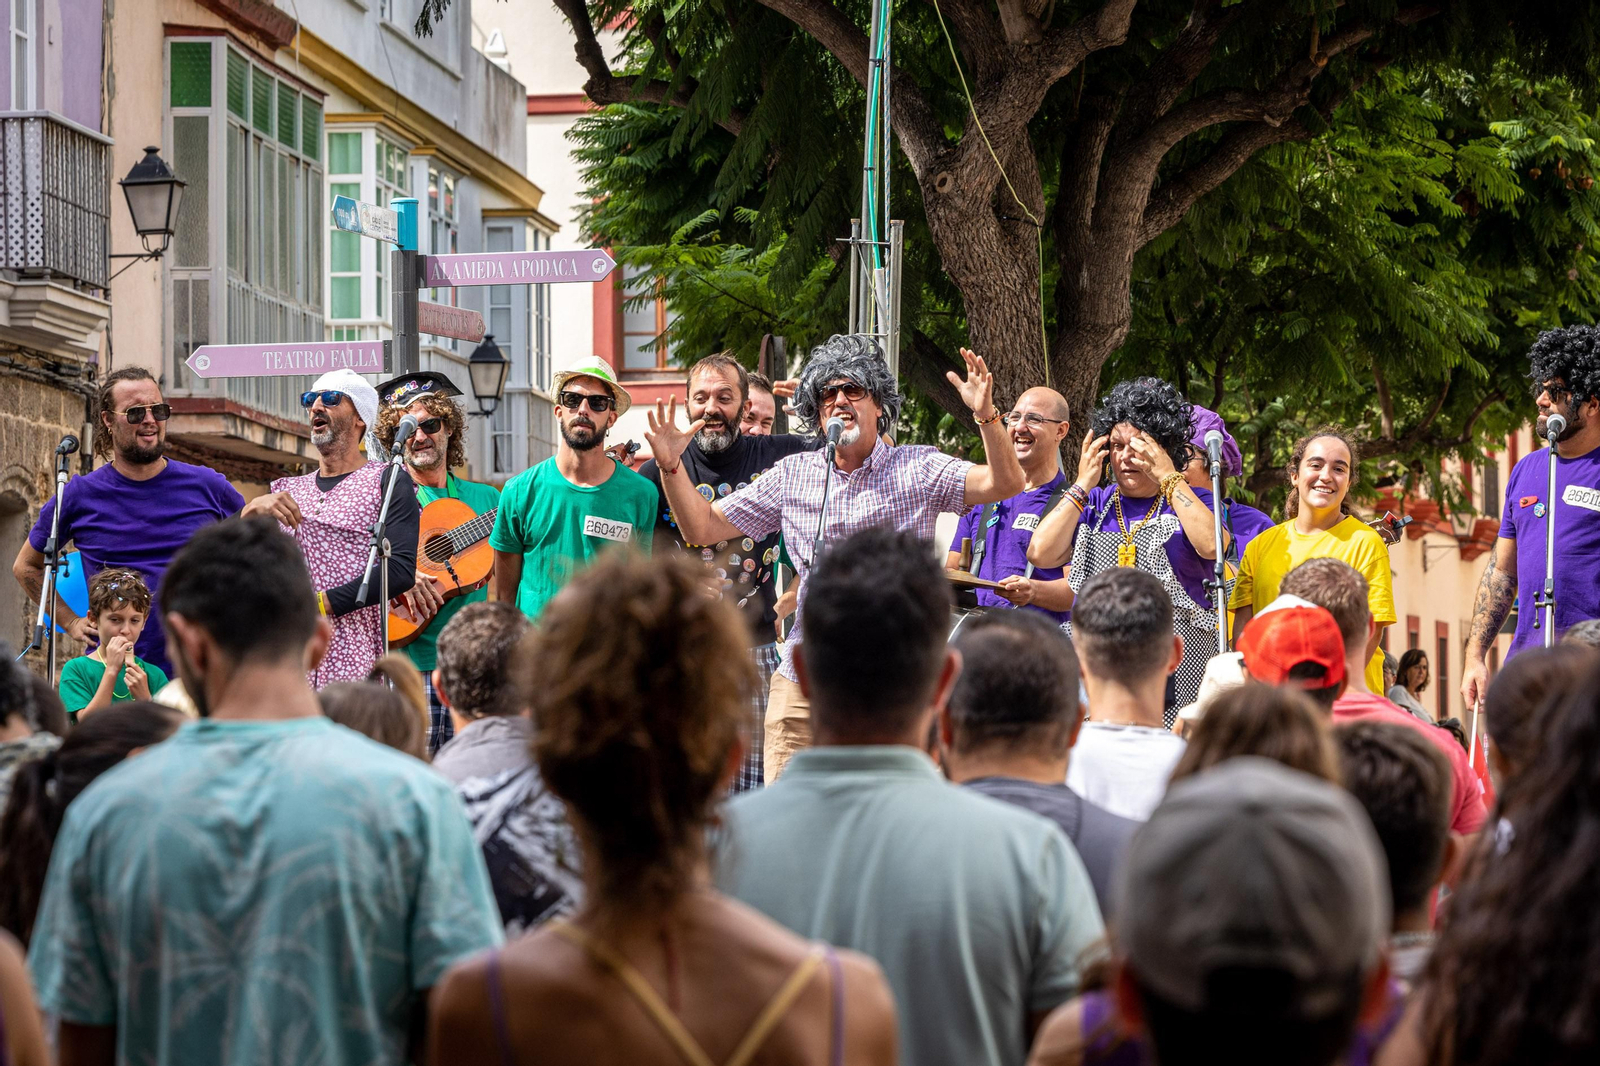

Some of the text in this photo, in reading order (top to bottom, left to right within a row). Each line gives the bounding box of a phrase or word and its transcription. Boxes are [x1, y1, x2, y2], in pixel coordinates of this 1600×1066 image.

[431, 257, 578, 281] ALAMEDA APODACA
[262, 348, 379, 370] TEATRO FALLA
[586, 519, 630, 539] 260473
